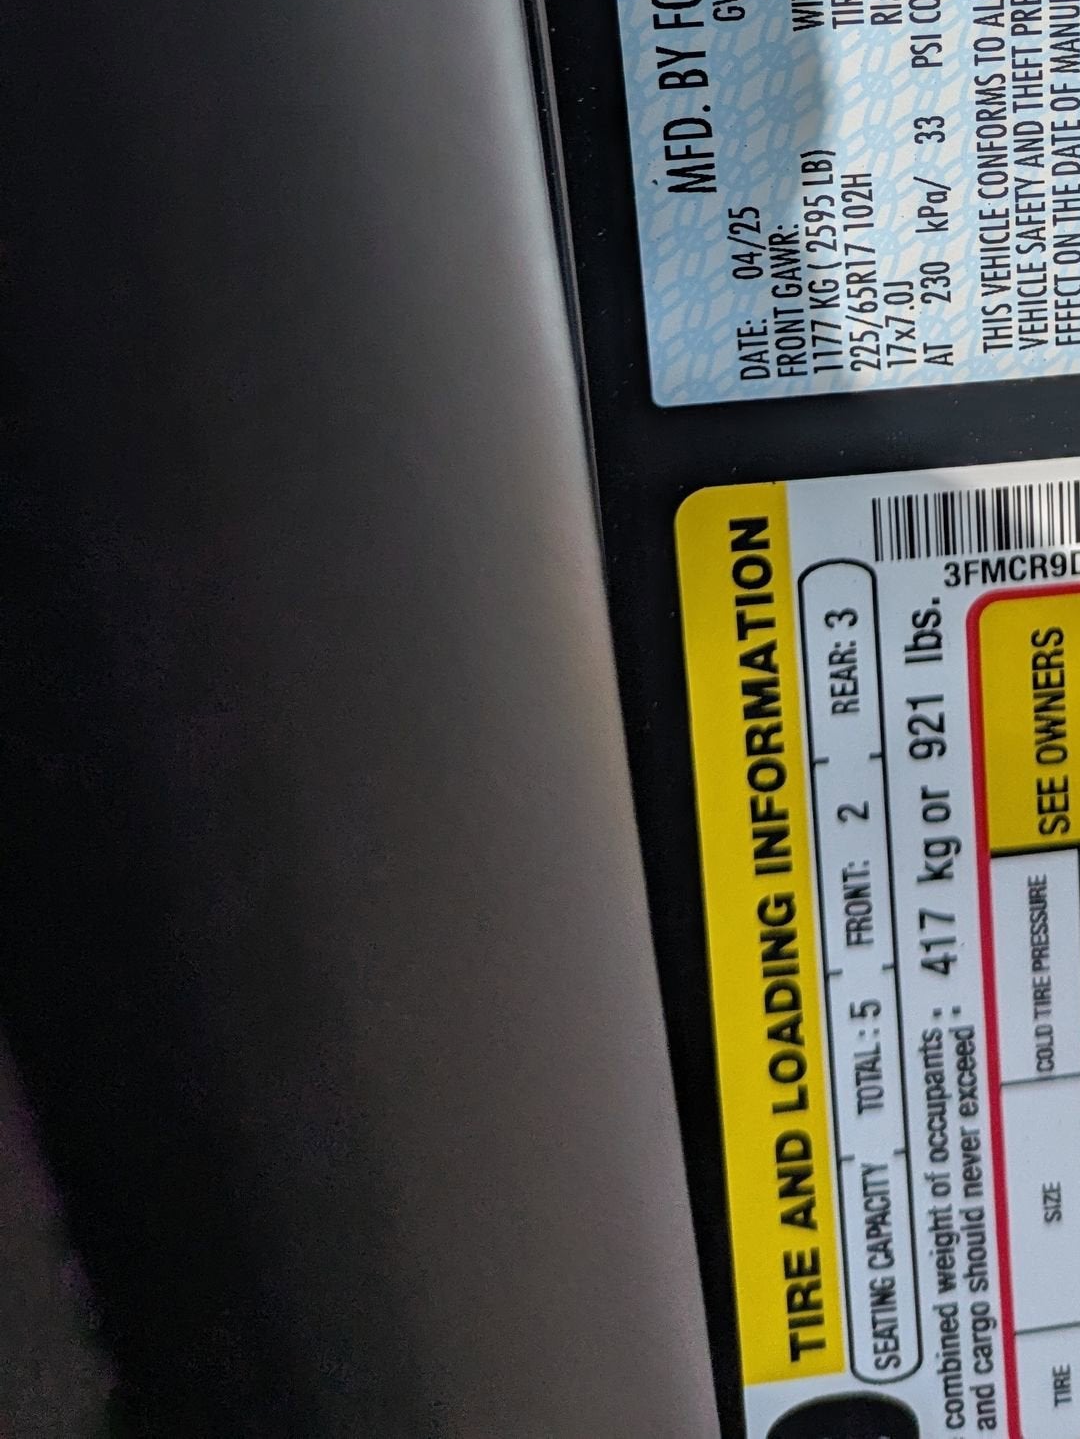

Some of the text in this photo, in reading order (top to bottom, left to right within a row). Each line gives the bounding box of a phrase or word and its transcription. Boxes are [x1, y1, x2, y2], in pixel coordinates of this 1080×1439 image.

[655, 45, 709, 90] BY
[909, 33, 943, 69] PSI
[972, 36, 1006, 67] TO
[1011, 45, 1044, 114] THEFT
[913, 115, 946, 145] 33
[973, 73, 1009, 200] CONFORMS
[1049, 82, 1080, 112] OF
[662, 104, 718, 194] MFD.
[1012, 120, 1045, 169] AND
[913, 176, 952, 234] kPa/
[1013, 176, 1047, 255] SAFETY
[727, 206, 771, 381] DATE: 04/25
[799, 149, 844, 375] 1177 KG 2595 LB)
[840, 173, 884, 372] 225/65R17 102H
[919, 261, 952, 305] 230
[978, 207, 1012, 297] VEHICLE
[768, 224, 808, 378] FRONT GAWR:
[882, 280, 917, 369] 17x7.0J
[980, 303, 1014, 354] THIS
[1016, 261, 1049, 351] VEHICLE
[922, 342, 954, 367] AT
[823, 608, 860, 715] REAR: 3
[1030, 627, 1071, 836] SEE OWNERS
[904, 597, 962, 976] 417 kg or 921 lbs.
[836, 801, 874, 947] FRONT: 2
[728, 516, 826, 1363] TIRE AND LOADING INFORMATION
[849, 1001, 882, 1020] 5
[918, 1028, 966, 1430] combined weight of occupants
[948, 1026, 998, 1431] and cargo should never exceed
[1042, 1182, 1063, 1225] SIZE
[861, 1164, 902, 1371] SEATING CAPACITY
[1052, 1365, 1072, 1408] TIRE
